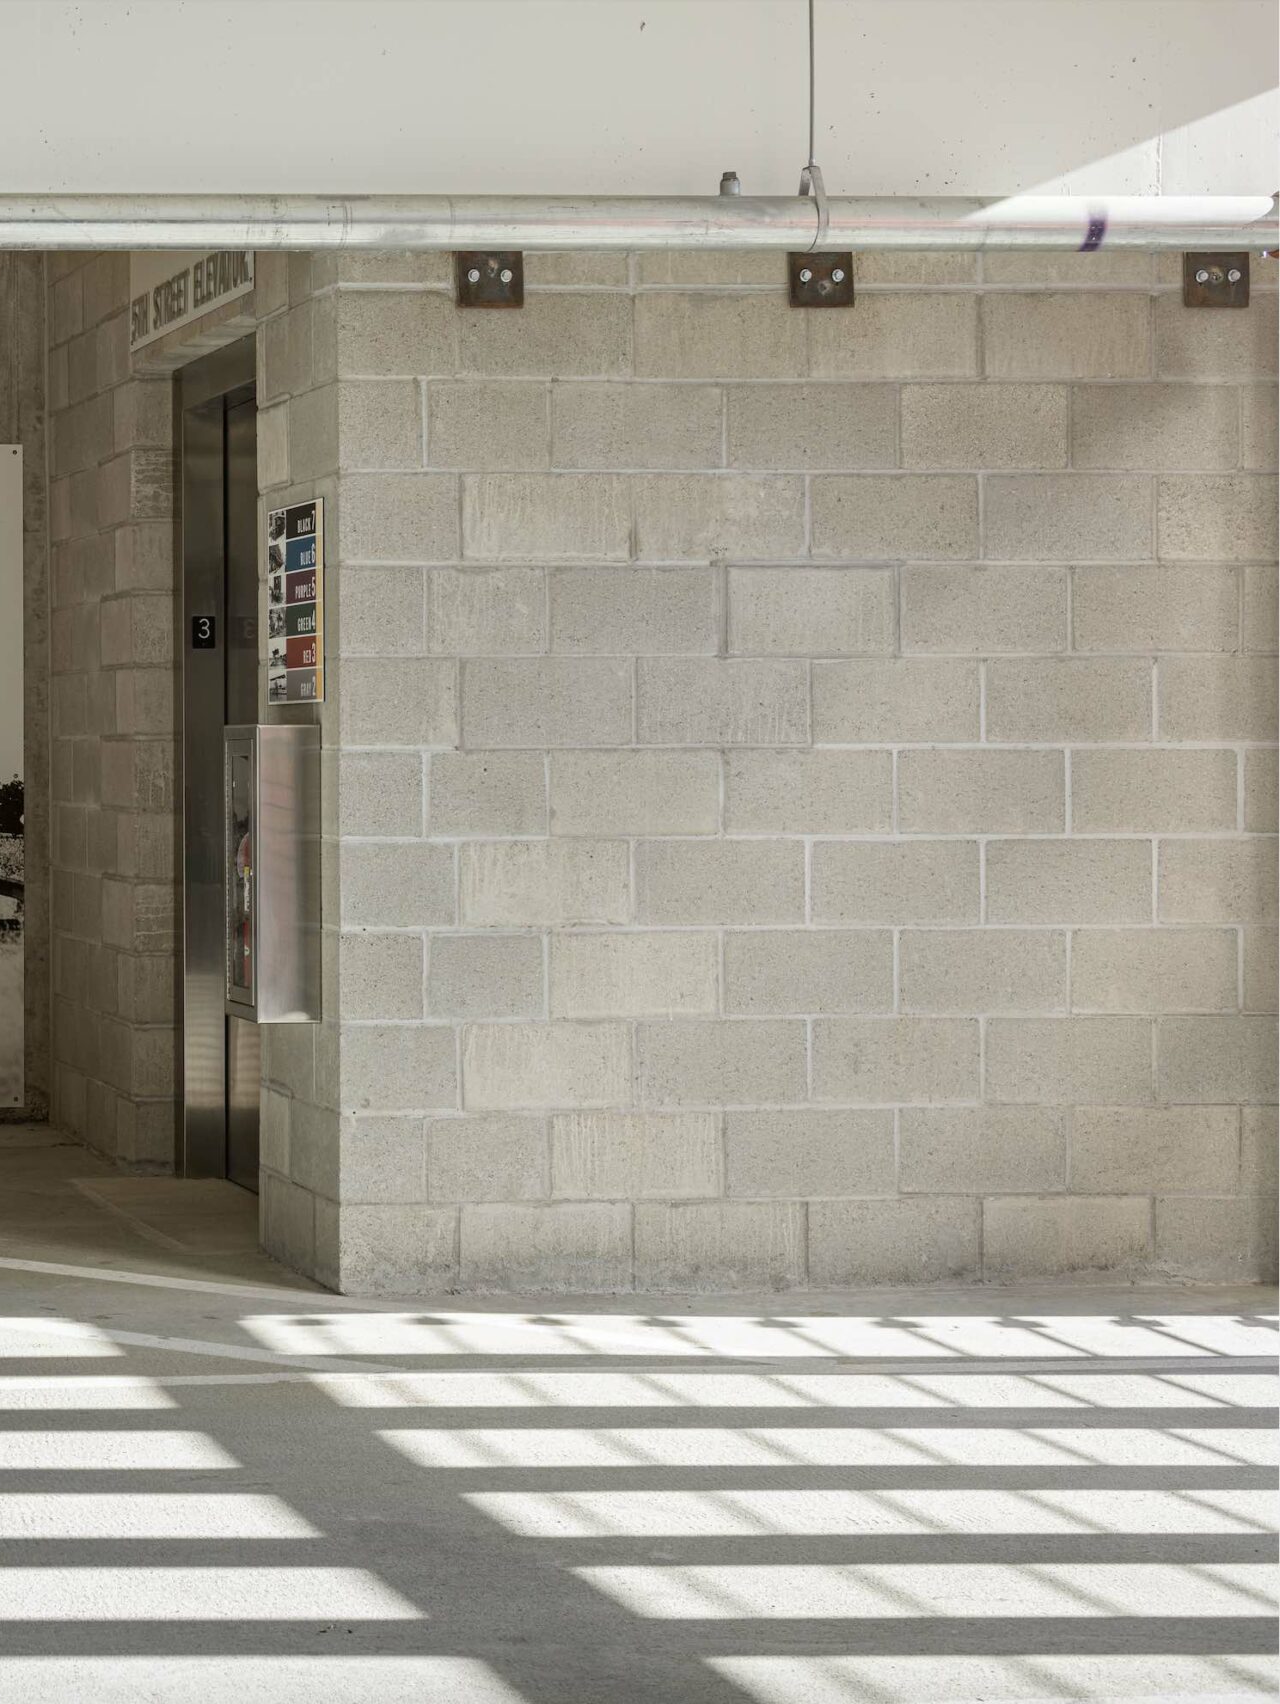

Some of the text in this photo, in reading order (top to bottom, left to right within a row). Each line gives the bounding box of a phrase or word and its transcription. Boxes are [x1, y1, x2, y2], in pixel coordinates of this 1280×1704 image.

[153, 267, 190, 331] STREET
[297, 510, 315, 534] BLACK 7
[300, 543, 315, 566] BLUE 6
[295, 576, 315, 599] PURPLE 5
[198, 618, 210, 639] 3
[297, 609, 316, 632] GREEN 4
[303, 642, 316, 664] RED 3
[311, 675, 316, 696] 2
